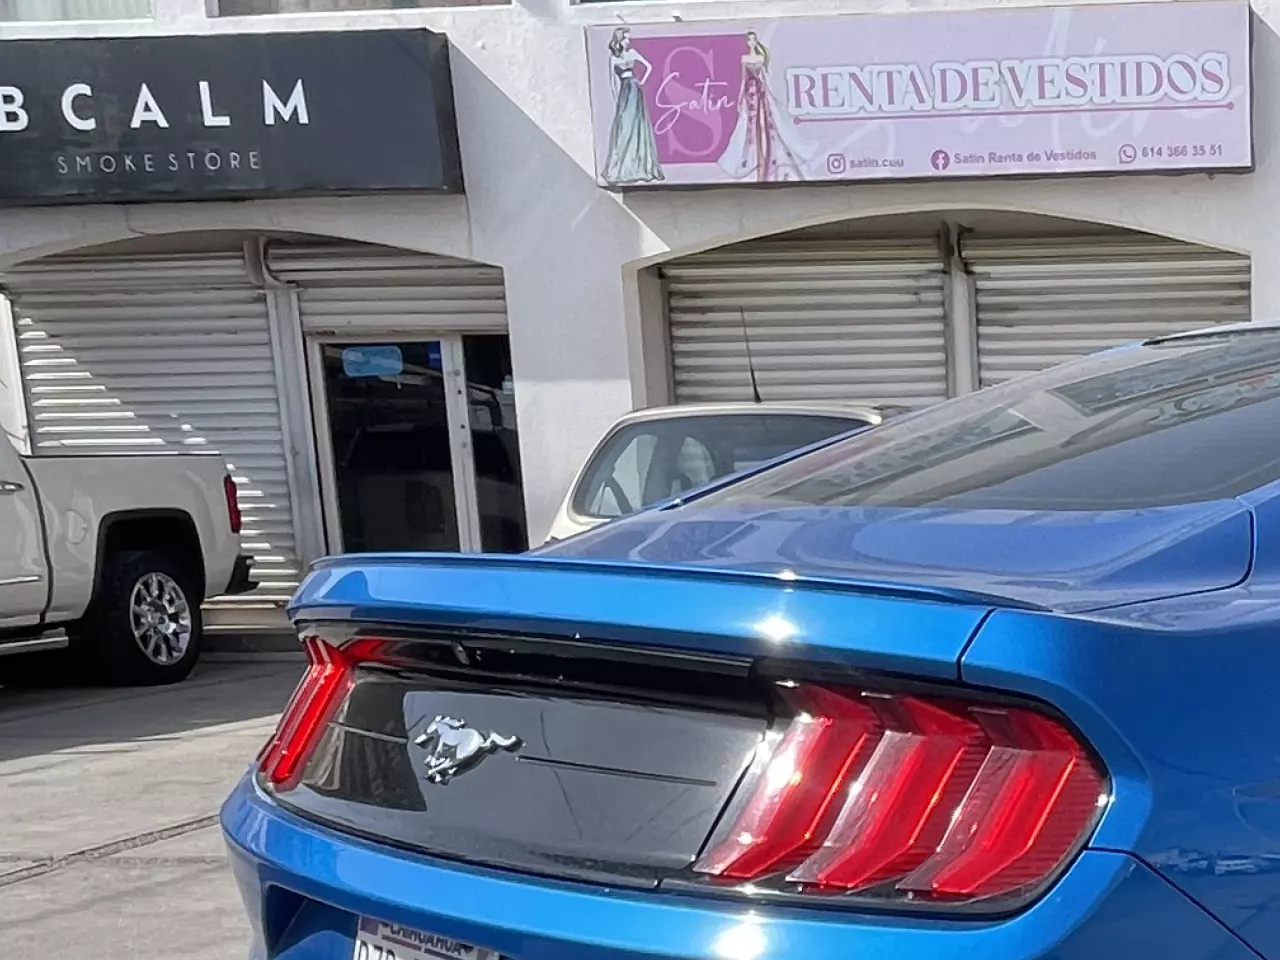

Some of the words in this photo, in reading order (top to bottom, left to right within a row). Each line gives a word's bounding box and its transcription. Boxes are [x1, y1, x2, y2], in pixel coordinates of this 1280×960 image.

[790, 66, 929, 110] RENTA
[938, 65, 998, 104] DE
[1006, 57, 1225, 101] VESTIDOS
[0, 79, 309, 131] BCALM
[655, 71, 735, 135] Satin
[57, 155, 156, 174] SMOKE
[168, 150, 262, 172] STORE
[849, 156, 905, 169] satin.cuu
[953, 152, 985, 164] Satin
[988, 151, 1024, 163] Renta
[1027, 151, 1042, 162] de
[1045, 149, 1097, 162] Vestidos
[1141, 147, 1163, 158] 614
[1192, 145, 1206, 156] 35
[1210, 144, 1224, 156] 51
